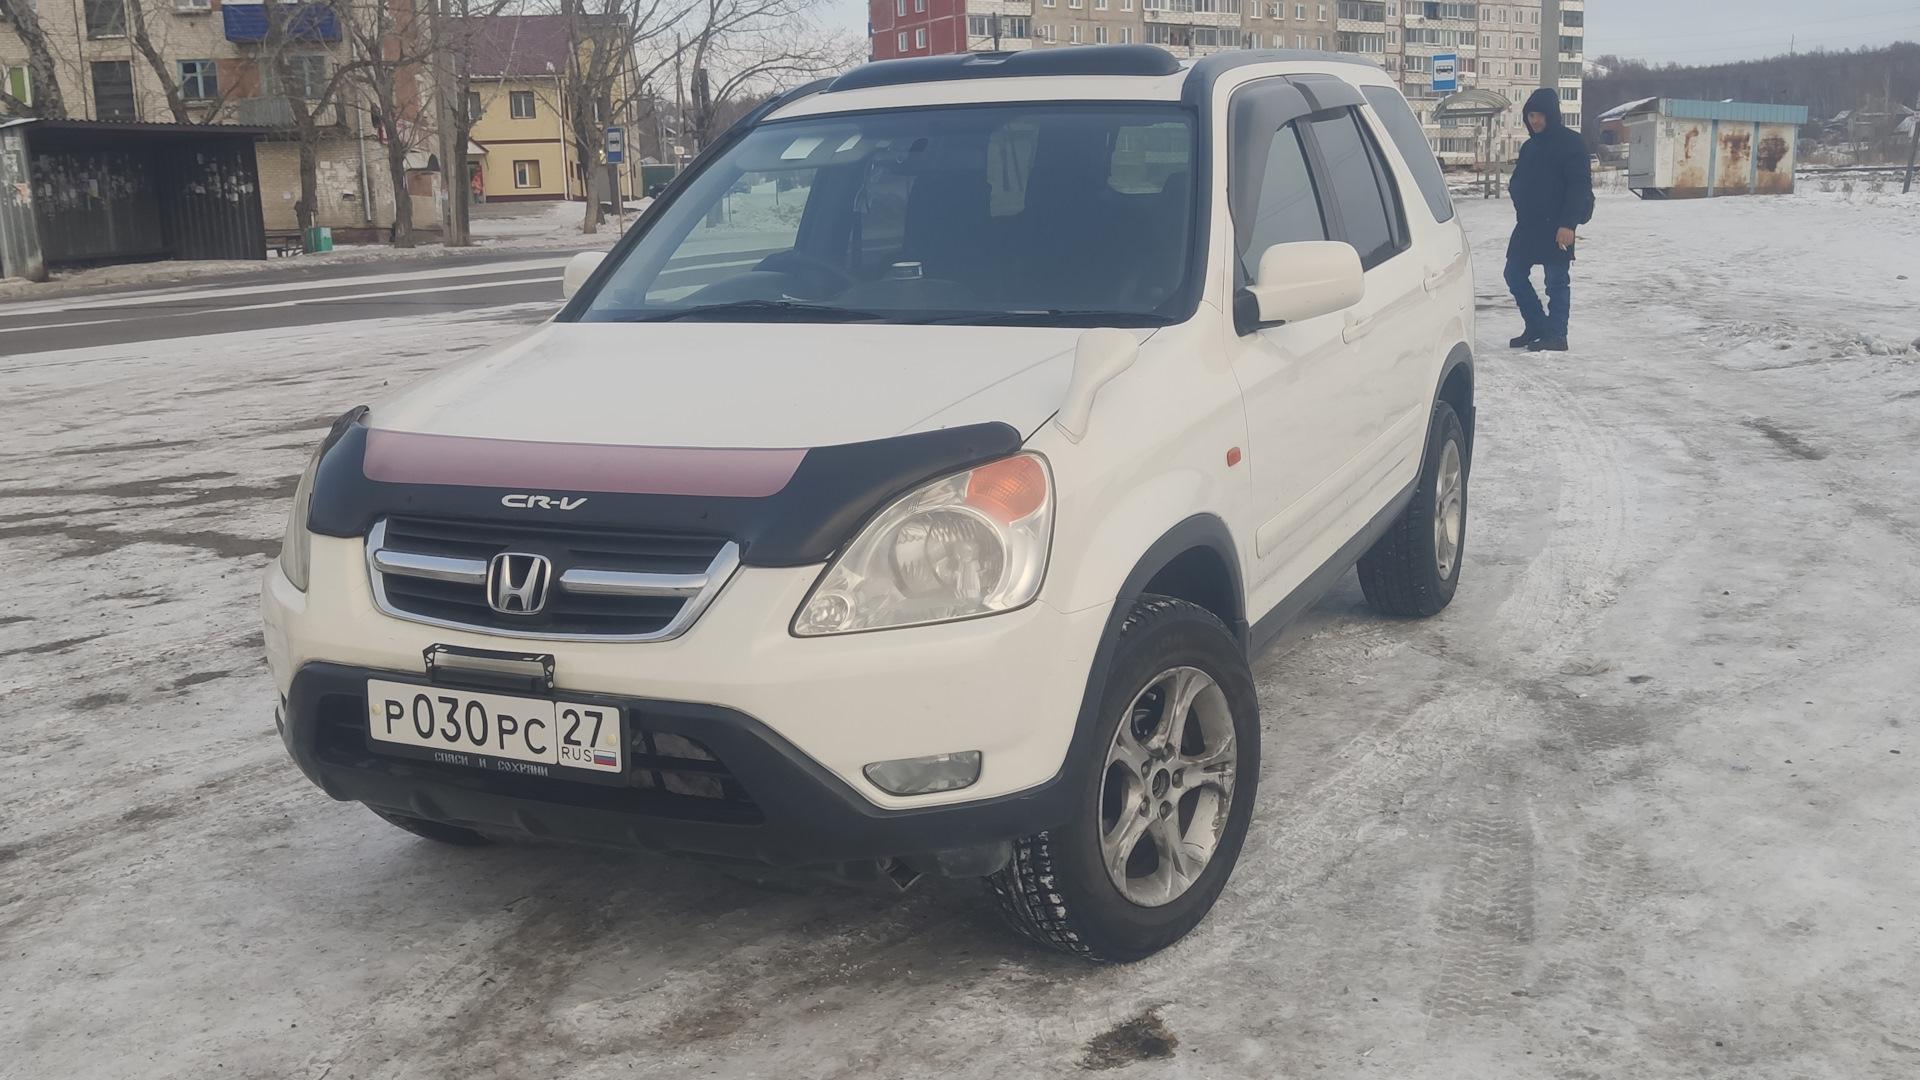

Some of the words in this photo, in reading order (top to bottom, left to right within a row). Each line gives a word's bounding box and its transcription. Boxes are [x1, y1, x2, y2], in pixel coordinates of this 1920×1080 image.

[501, 494, 588, 510] CR-V
[562, 709, 603, 748] 27
[561, 746, 592, 762] RUS
